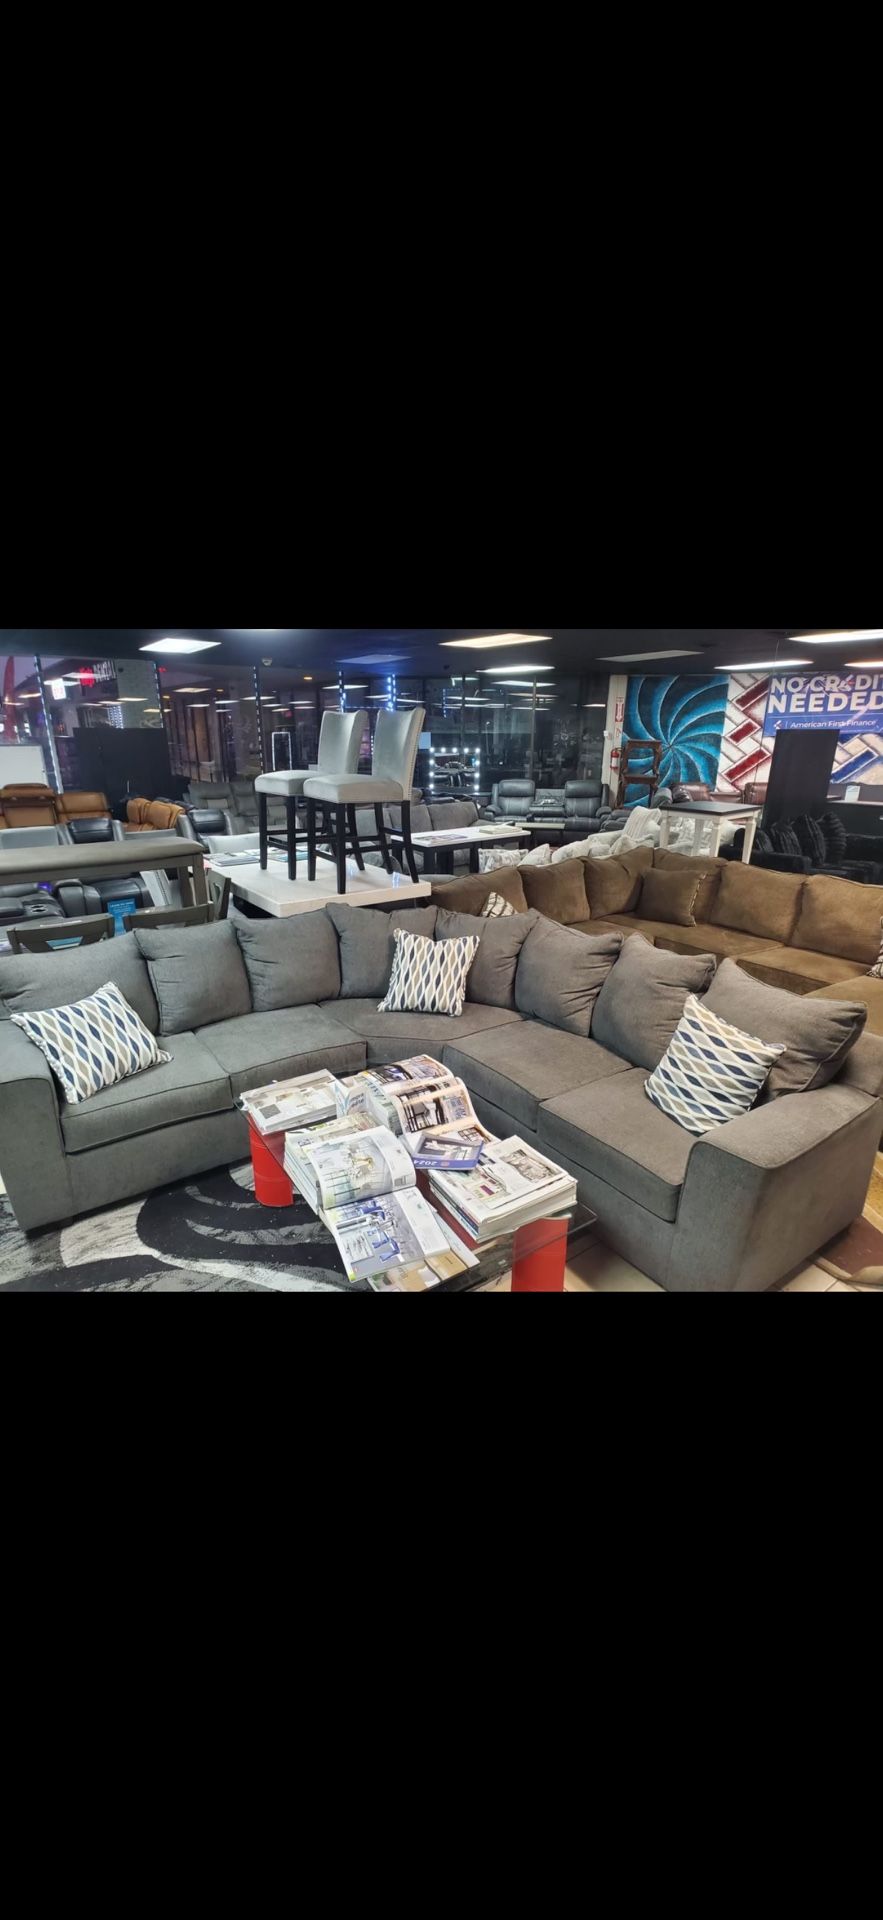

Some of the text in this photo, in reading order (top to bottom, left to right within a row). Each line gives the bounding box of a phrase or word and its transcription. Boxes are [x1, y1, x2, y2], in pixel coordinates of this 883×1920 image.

[770, 677, 804, 693] NO
[768, 690, 883, 713] NEEDED
[790, 720, 827, 728] American
[846, 718, 877, 727] Finance
